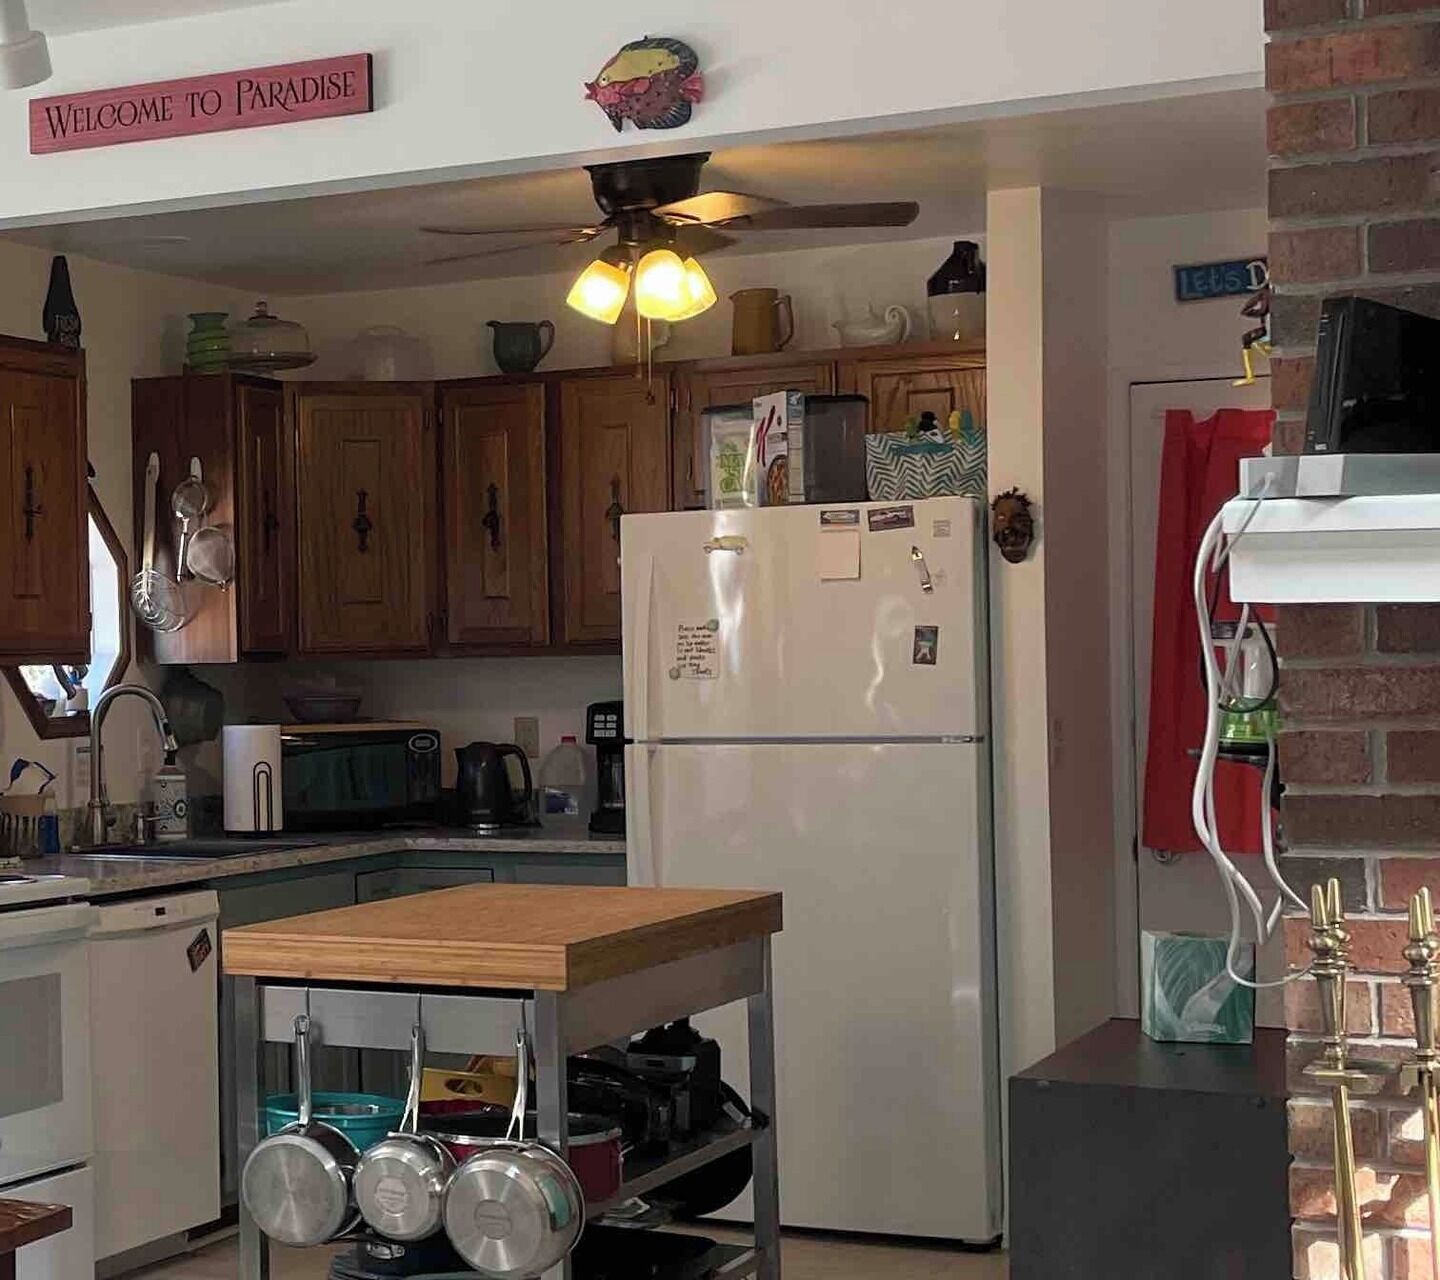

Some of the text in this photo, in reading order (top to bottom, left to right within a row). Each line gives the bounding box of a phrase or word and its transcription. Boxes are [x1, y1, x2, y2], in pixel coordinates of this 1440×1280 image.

[44, 70, 356, 139] WELCOME TO PARADISE
